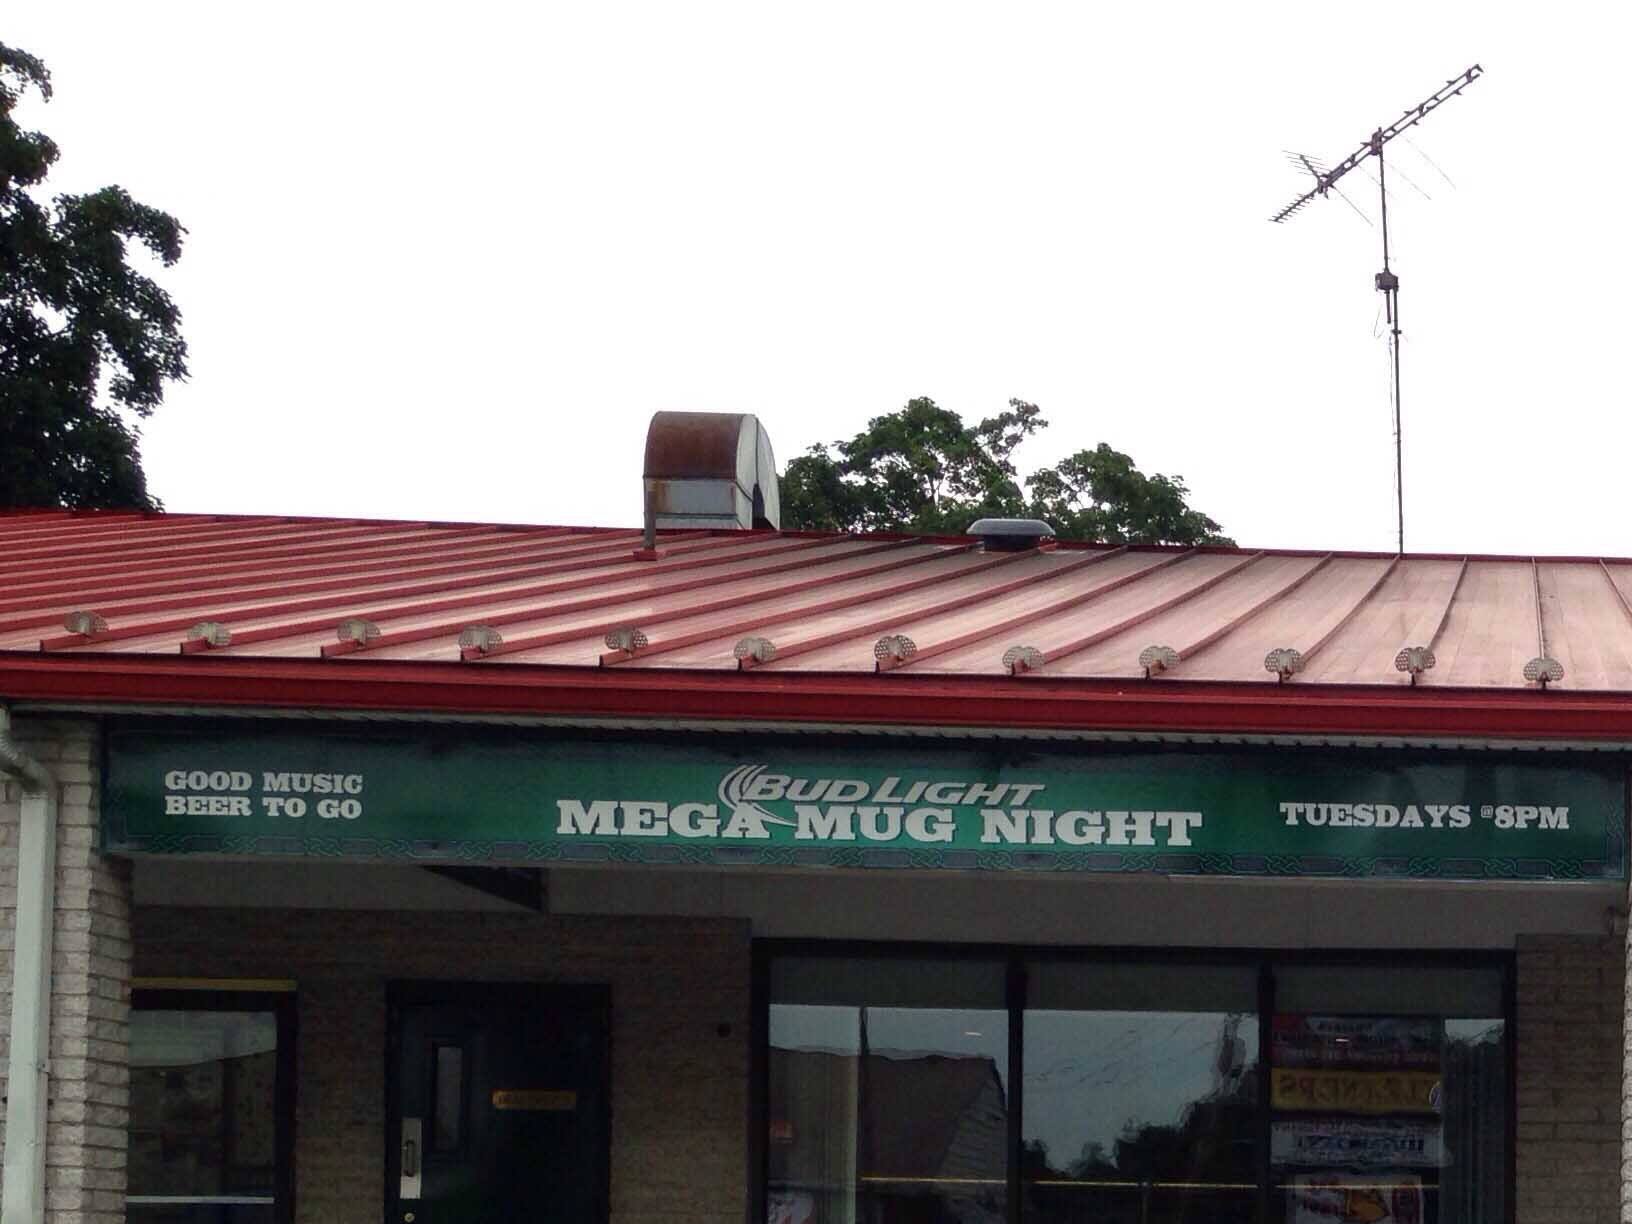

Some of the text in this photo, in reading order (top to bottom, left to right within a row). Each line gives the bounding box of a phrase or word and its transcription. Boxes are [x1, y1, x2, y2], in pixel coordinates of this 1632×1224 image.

[164, 770, 364, 794] GOOD MUSIC
[748, 774, 1046, 806] BUD LIGHT
[164, 796, 363, 819] BEER TO GO
[1279, 802, 1472, 829] TUESDAYS
[556, 799, 1203, 846] MEGA MUG NIGHT
